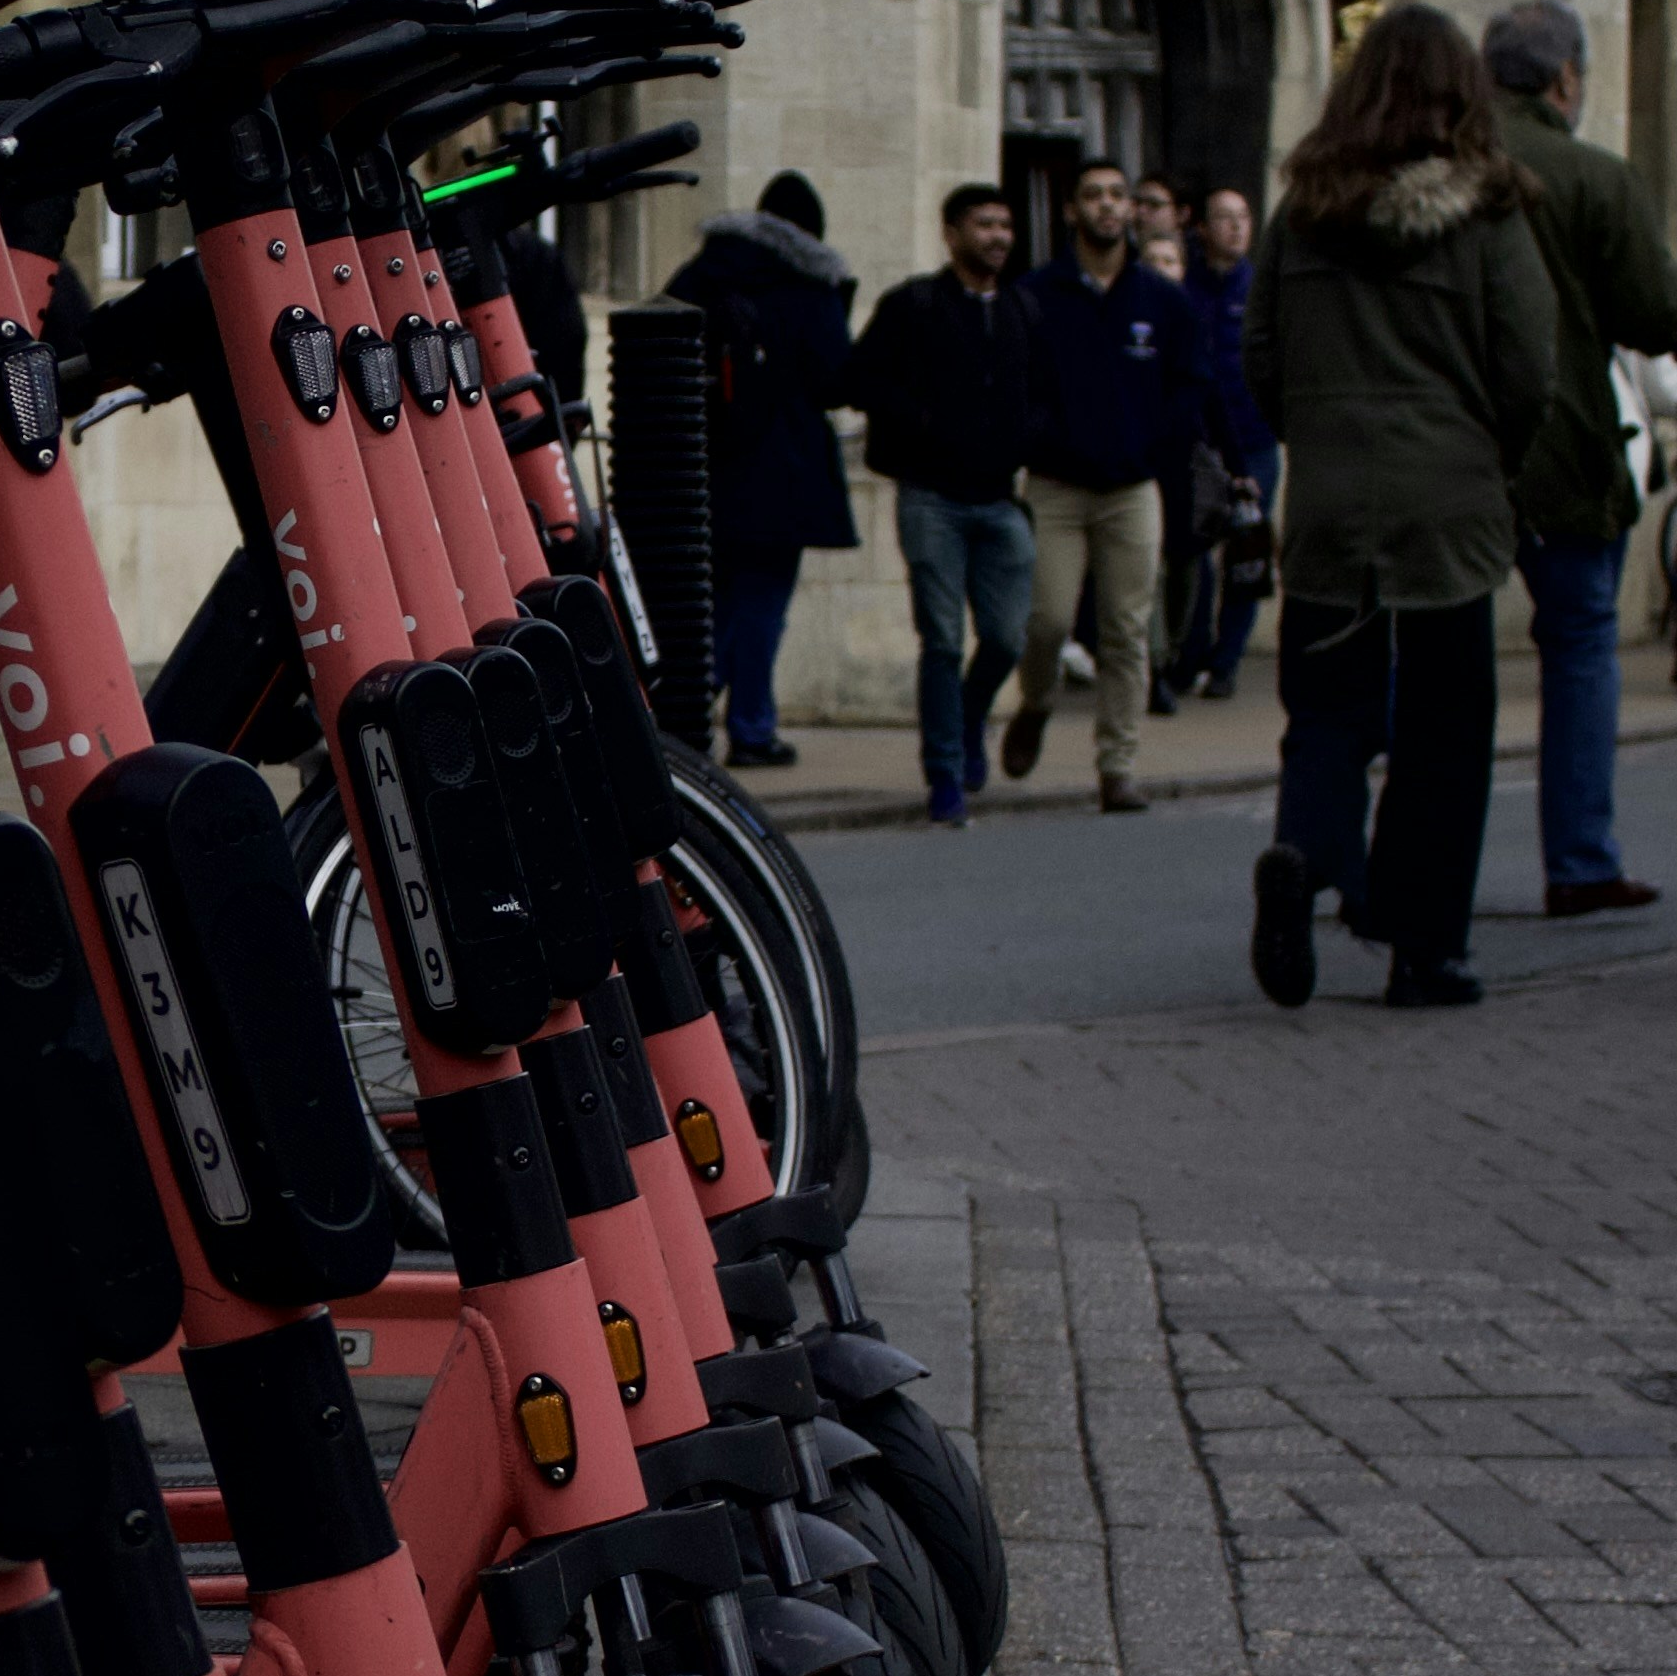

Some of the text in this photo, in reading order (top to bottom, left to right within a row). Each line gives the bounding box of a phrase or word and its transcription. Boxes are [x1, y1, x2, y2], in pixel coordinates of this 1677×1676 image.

[274, 508, 345, 680] voi.
[375, 746, 445, 987] ALD9
[117, 893, 221, 1170] K3M9
